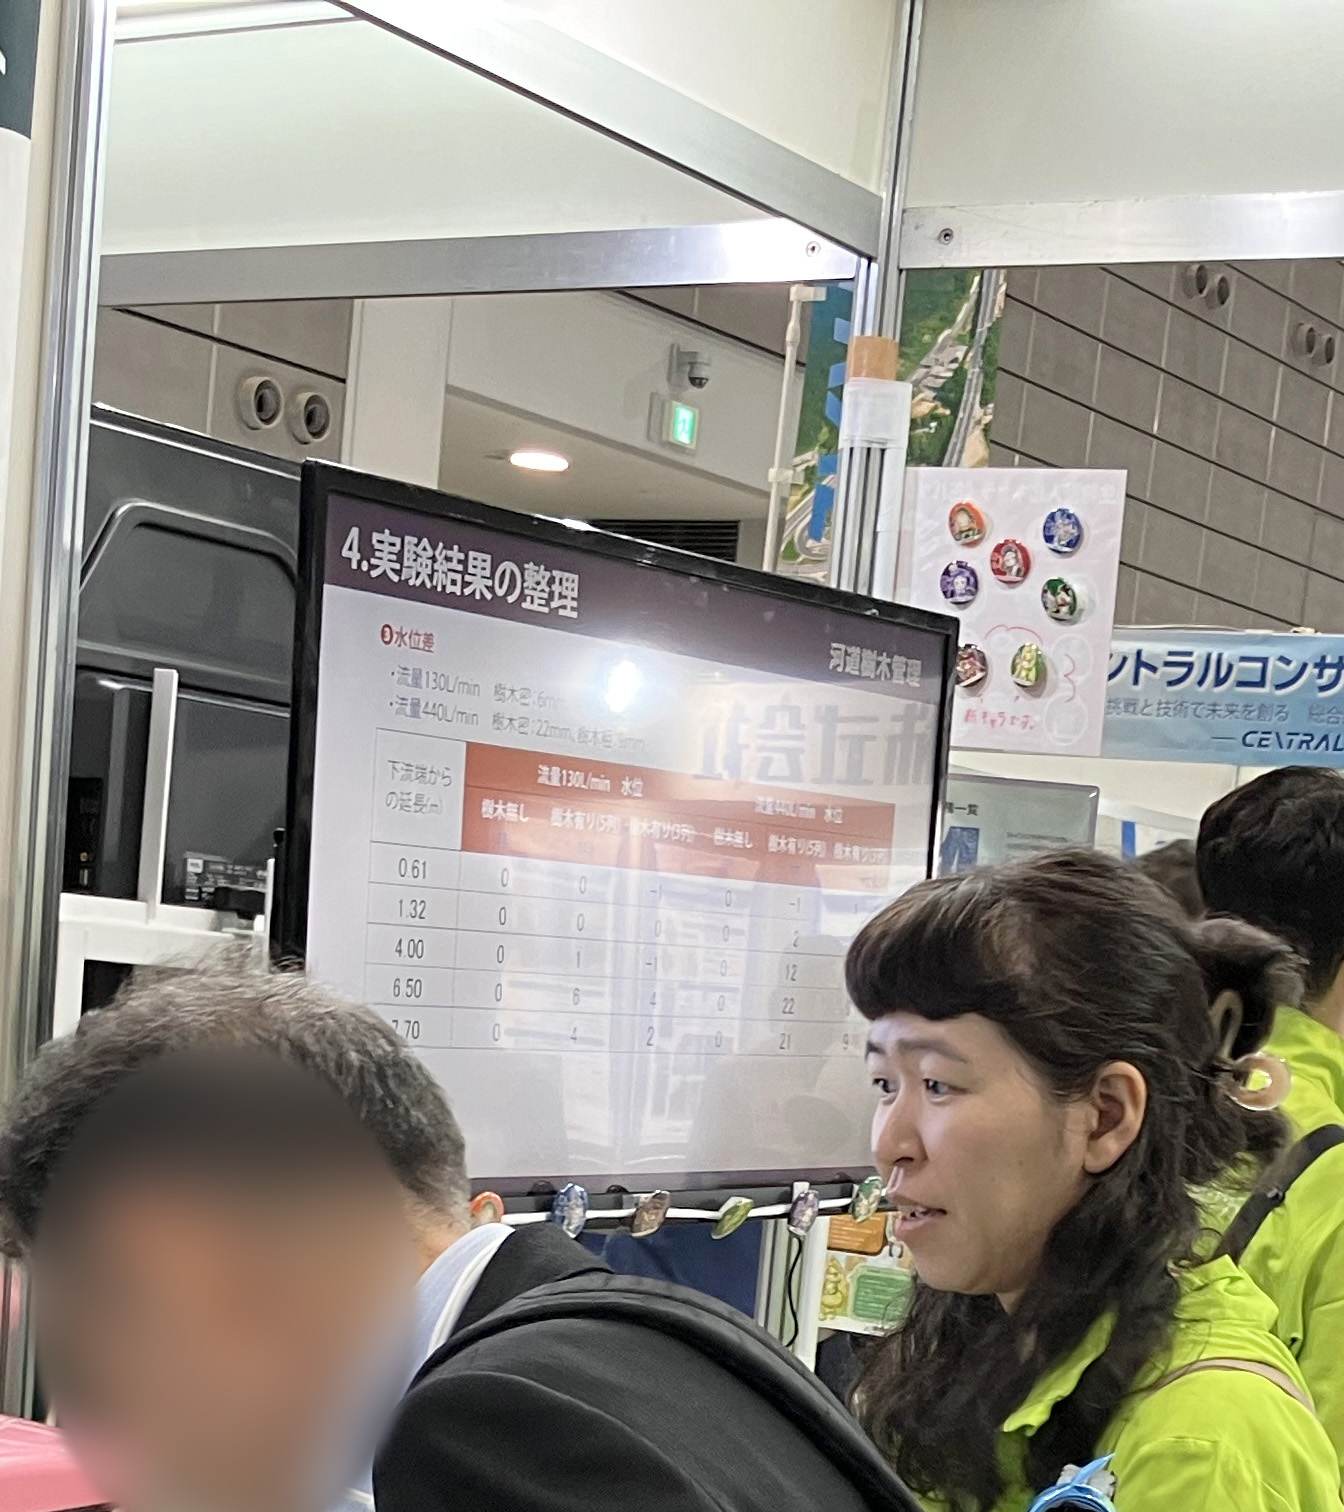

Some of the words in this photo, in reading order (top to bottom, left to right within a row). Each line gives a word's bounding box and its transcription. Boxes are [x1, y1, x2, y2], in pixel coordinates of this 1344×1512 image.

[341, 526, 578, 618] 4.実験結果の整理
[1241, 730, 1344, 752] CENTRAL
[501, 868, 509, 888] 0
[499, 906, 507, 926] 0
[576, 912, 585, 931] 0
[496, 944, 505, 964] 0
[494, 983, 503, 1002] 0
[782, 997, 795, 1015] 22
[492, 1023, 501, 1042] 0
